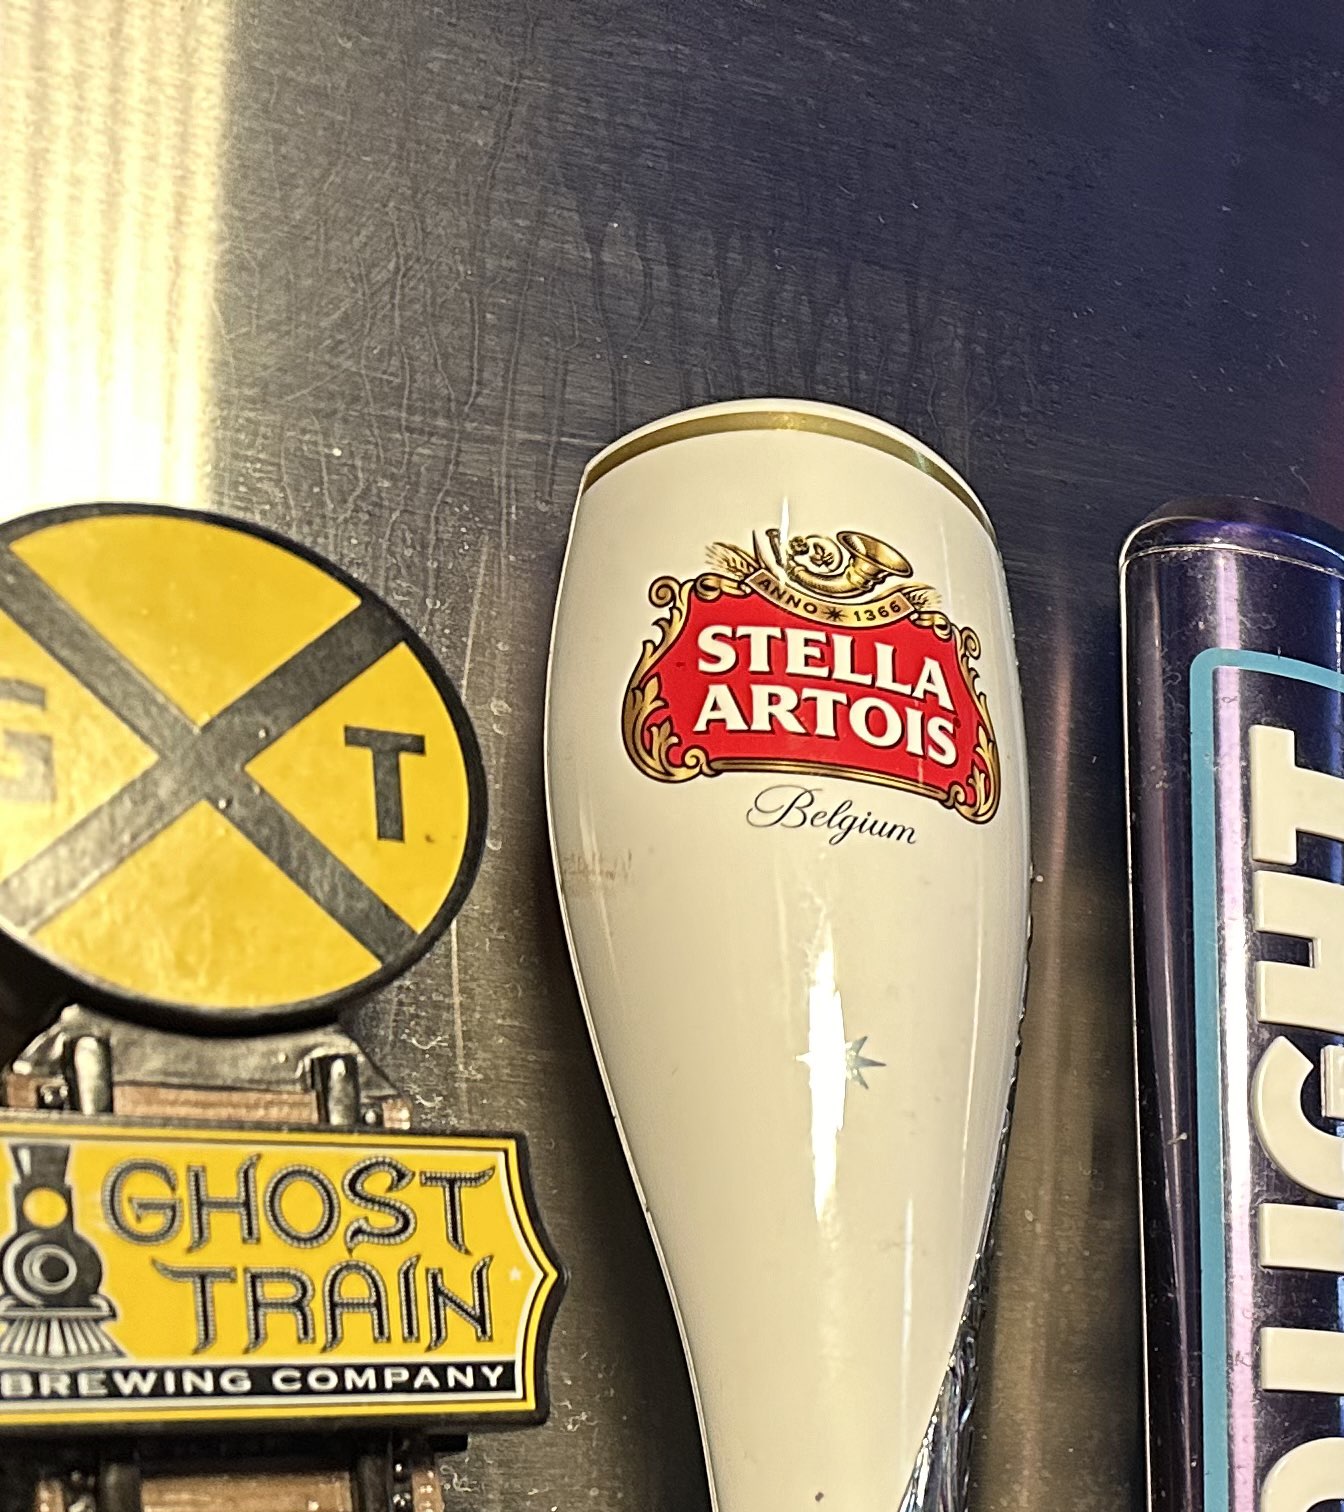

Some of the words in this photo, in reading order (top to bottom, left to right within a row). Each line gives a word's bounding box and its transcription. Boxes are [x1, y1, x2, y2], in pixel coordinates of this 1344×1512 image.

[758, 576, 817, 615] ANNO
[854, 601, 902, 623] 1366
[697, 624, 955, 712] STELLA
[693, 684, 958, 767] ARTOIS
[344, 725, 426, 843] T
[745, 784, 918, 847] Belgium
[102, 1153, 496, 1255] GHOST
[151, 1253, 495, 1354] TRAIN
[1, 1367, 252, 1397] BREWING
[272, 1366, 505, 1392] COMPANY
